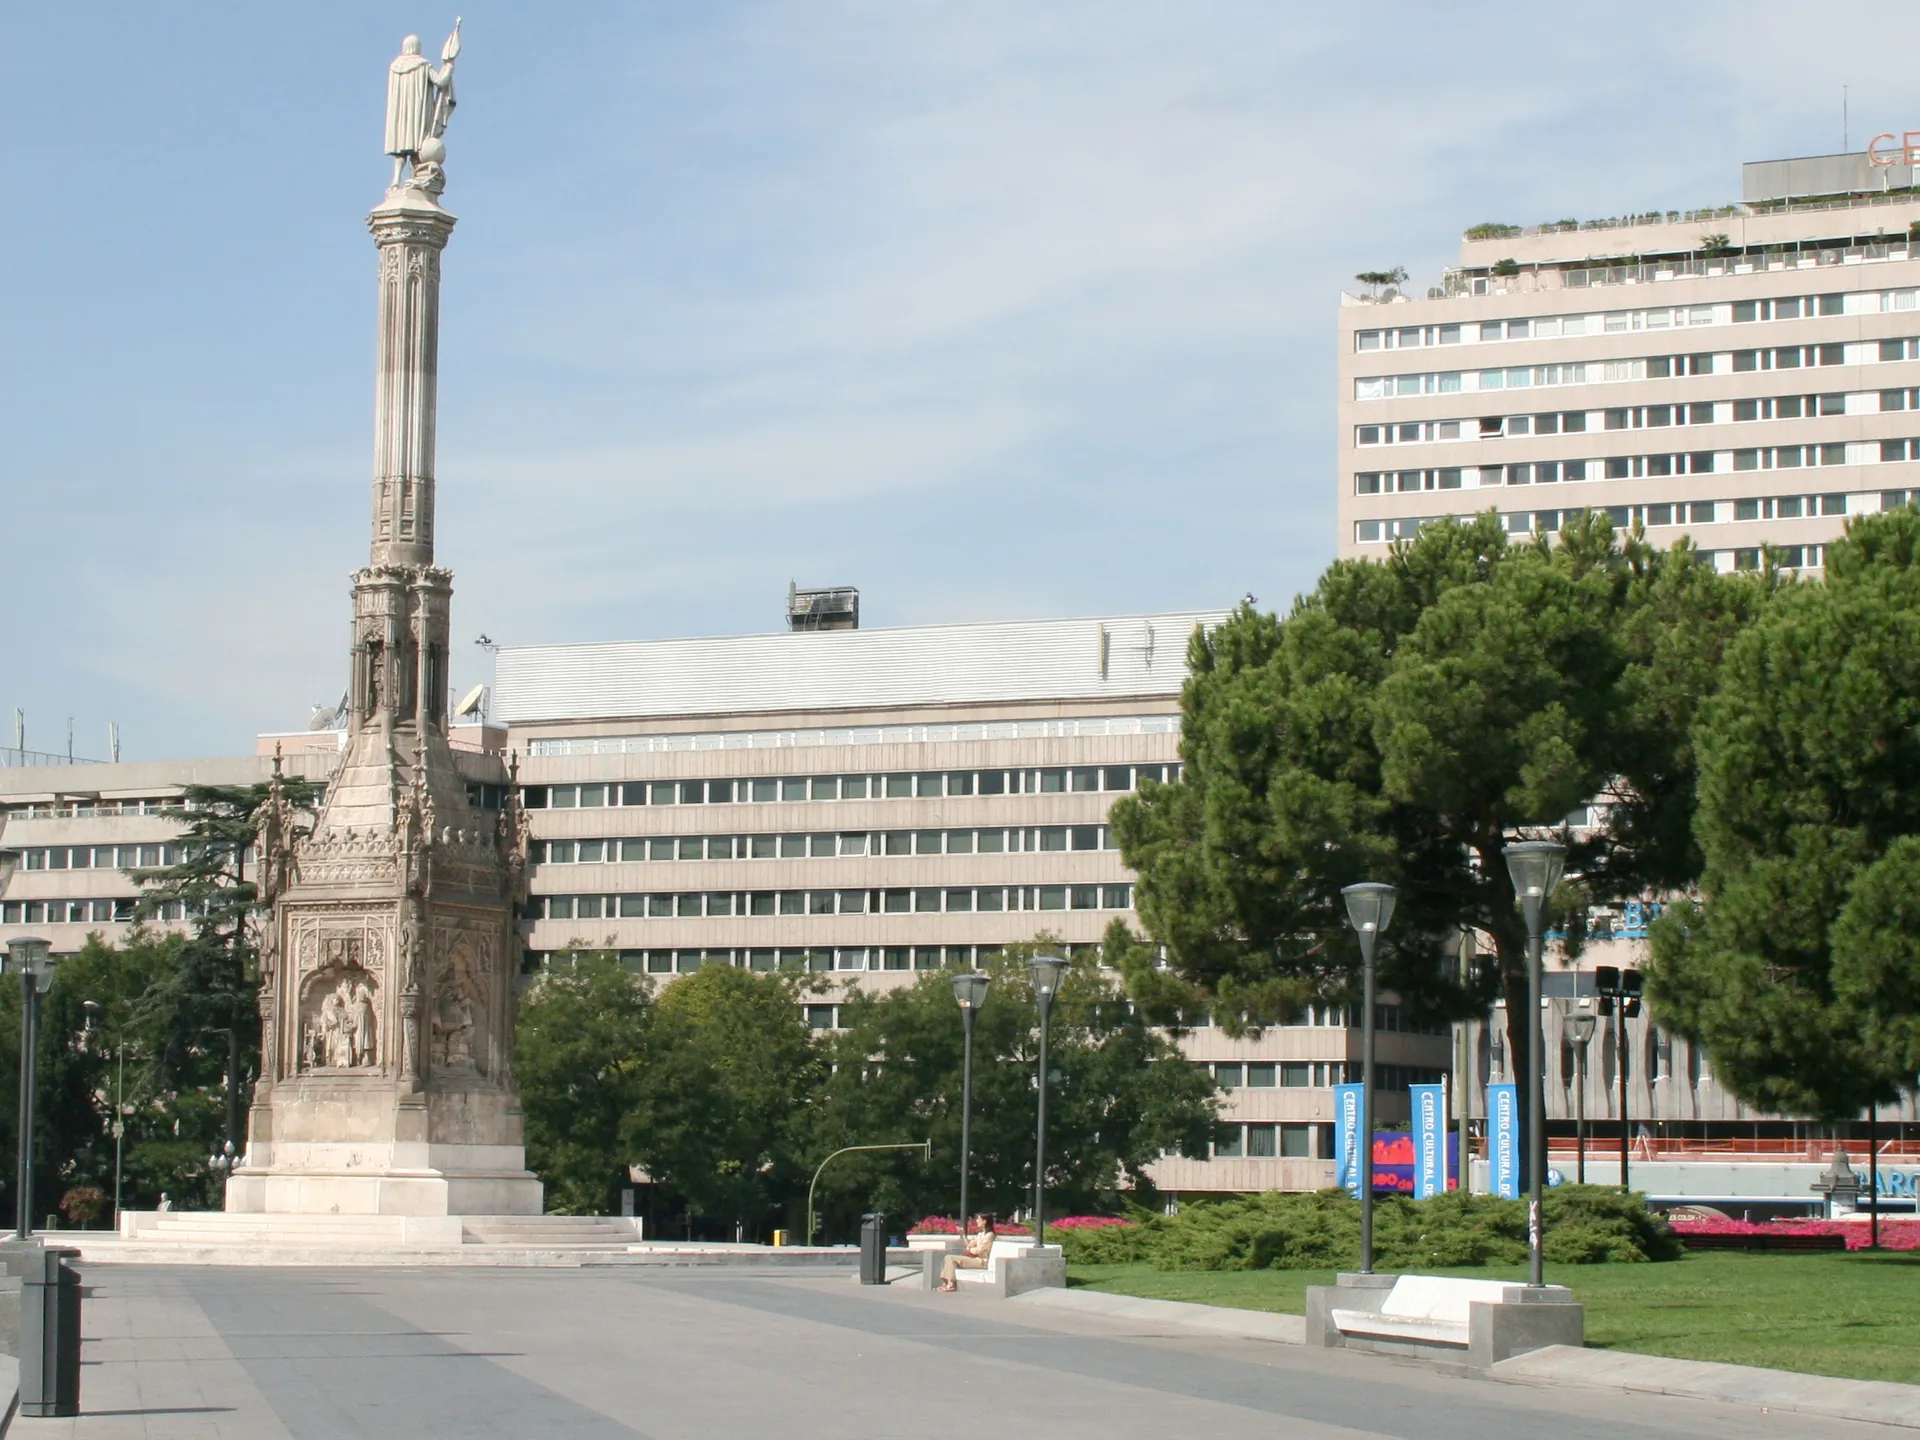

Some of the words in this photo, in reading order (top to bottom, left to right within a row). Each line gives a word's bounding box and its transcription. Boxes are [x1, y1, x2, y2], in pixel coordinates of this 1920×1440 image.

[1343, 1091, 1356, 1130] CENTRO
[1421, 1091, 1433, 1130] CENTRO
[1498, 1091, 1510, 1130] CENTRO
[1423, 1132, 1434, 1181] CULTURAL
[1498, 1130, 1510, 1181] CULTURAL
